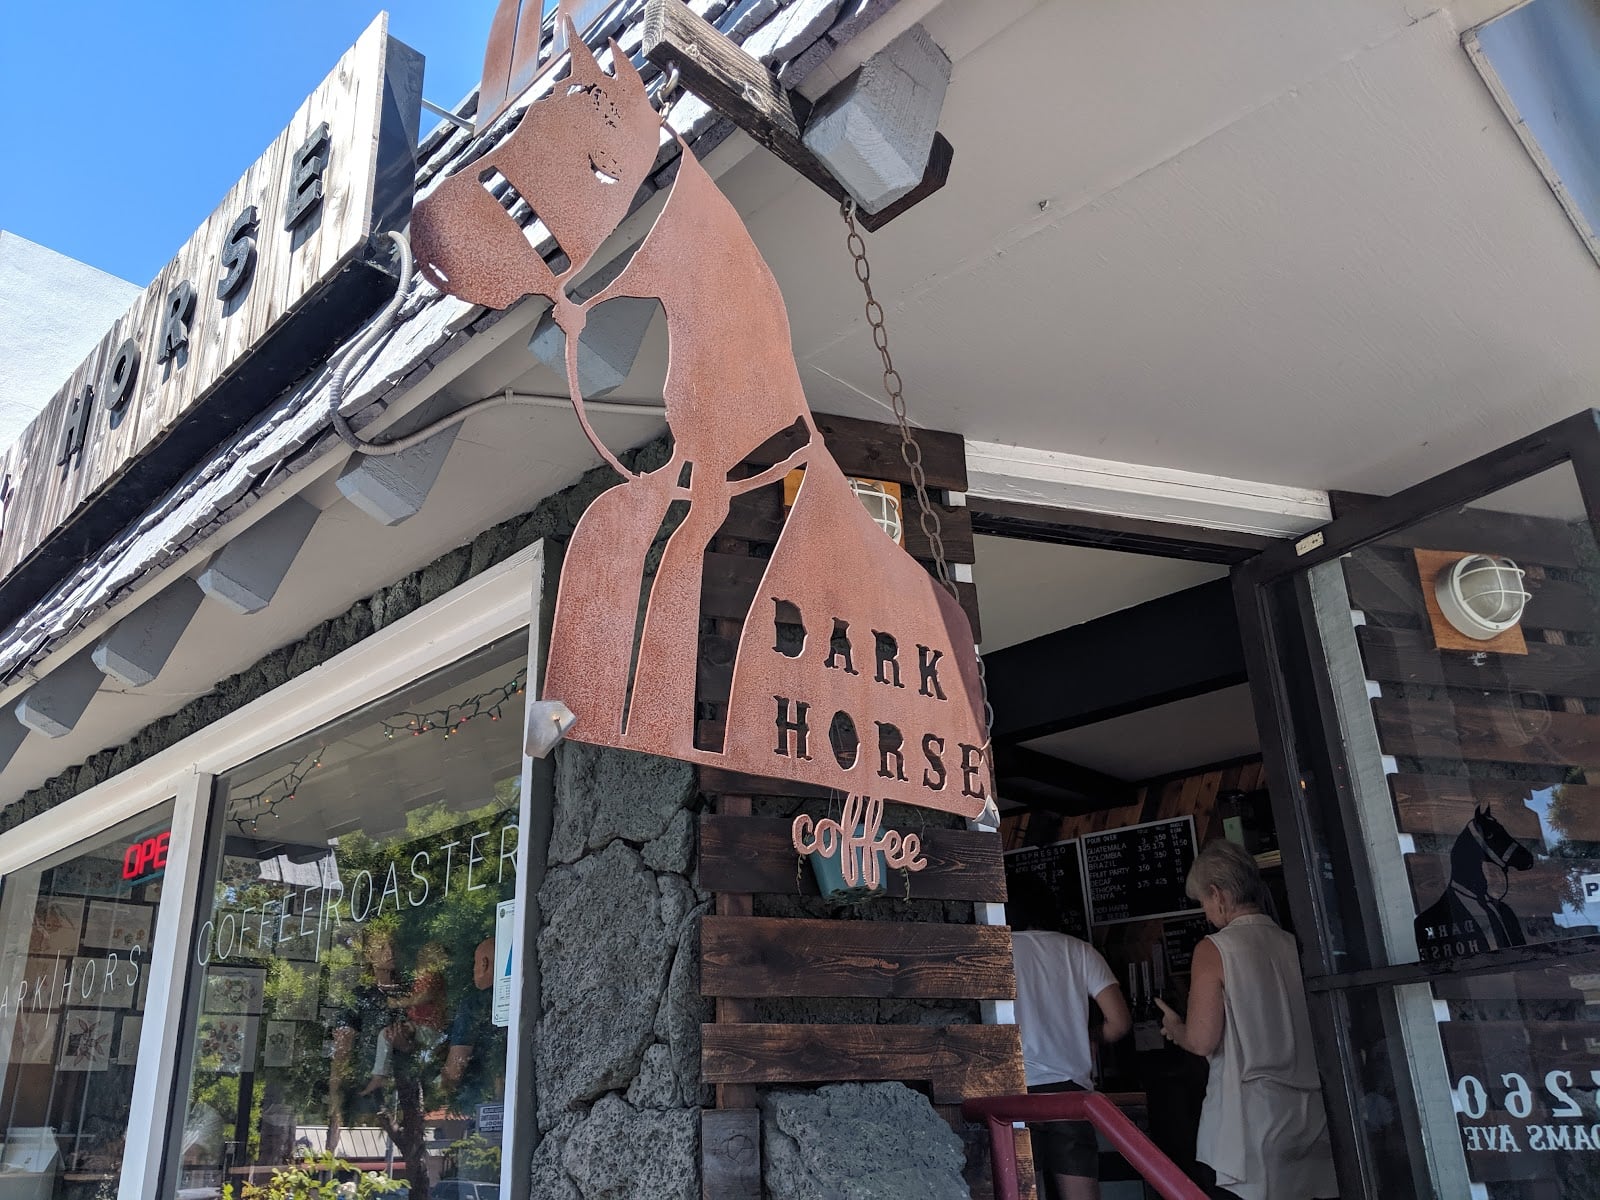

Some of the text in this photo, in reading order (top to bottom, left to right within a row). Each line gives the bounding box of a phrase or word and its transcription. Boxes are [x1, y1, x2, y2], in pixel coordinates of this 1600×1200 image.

[57, 121, 330, 466] HORSE
[771, 597, 947, 700] DARK
[773, 695, 985, 799] HORSE
[123, 831, 171, 880] OPE
[792, 794, 927, 890] coffee
[1015, 846, 1066, 862] ESPRESSO
[1086, 842, 1127, 854] GUATEMALA
[1087, 851, 1122, 863] COLOMBIA
[1088, 860, 1118, 871] BRAZIL
